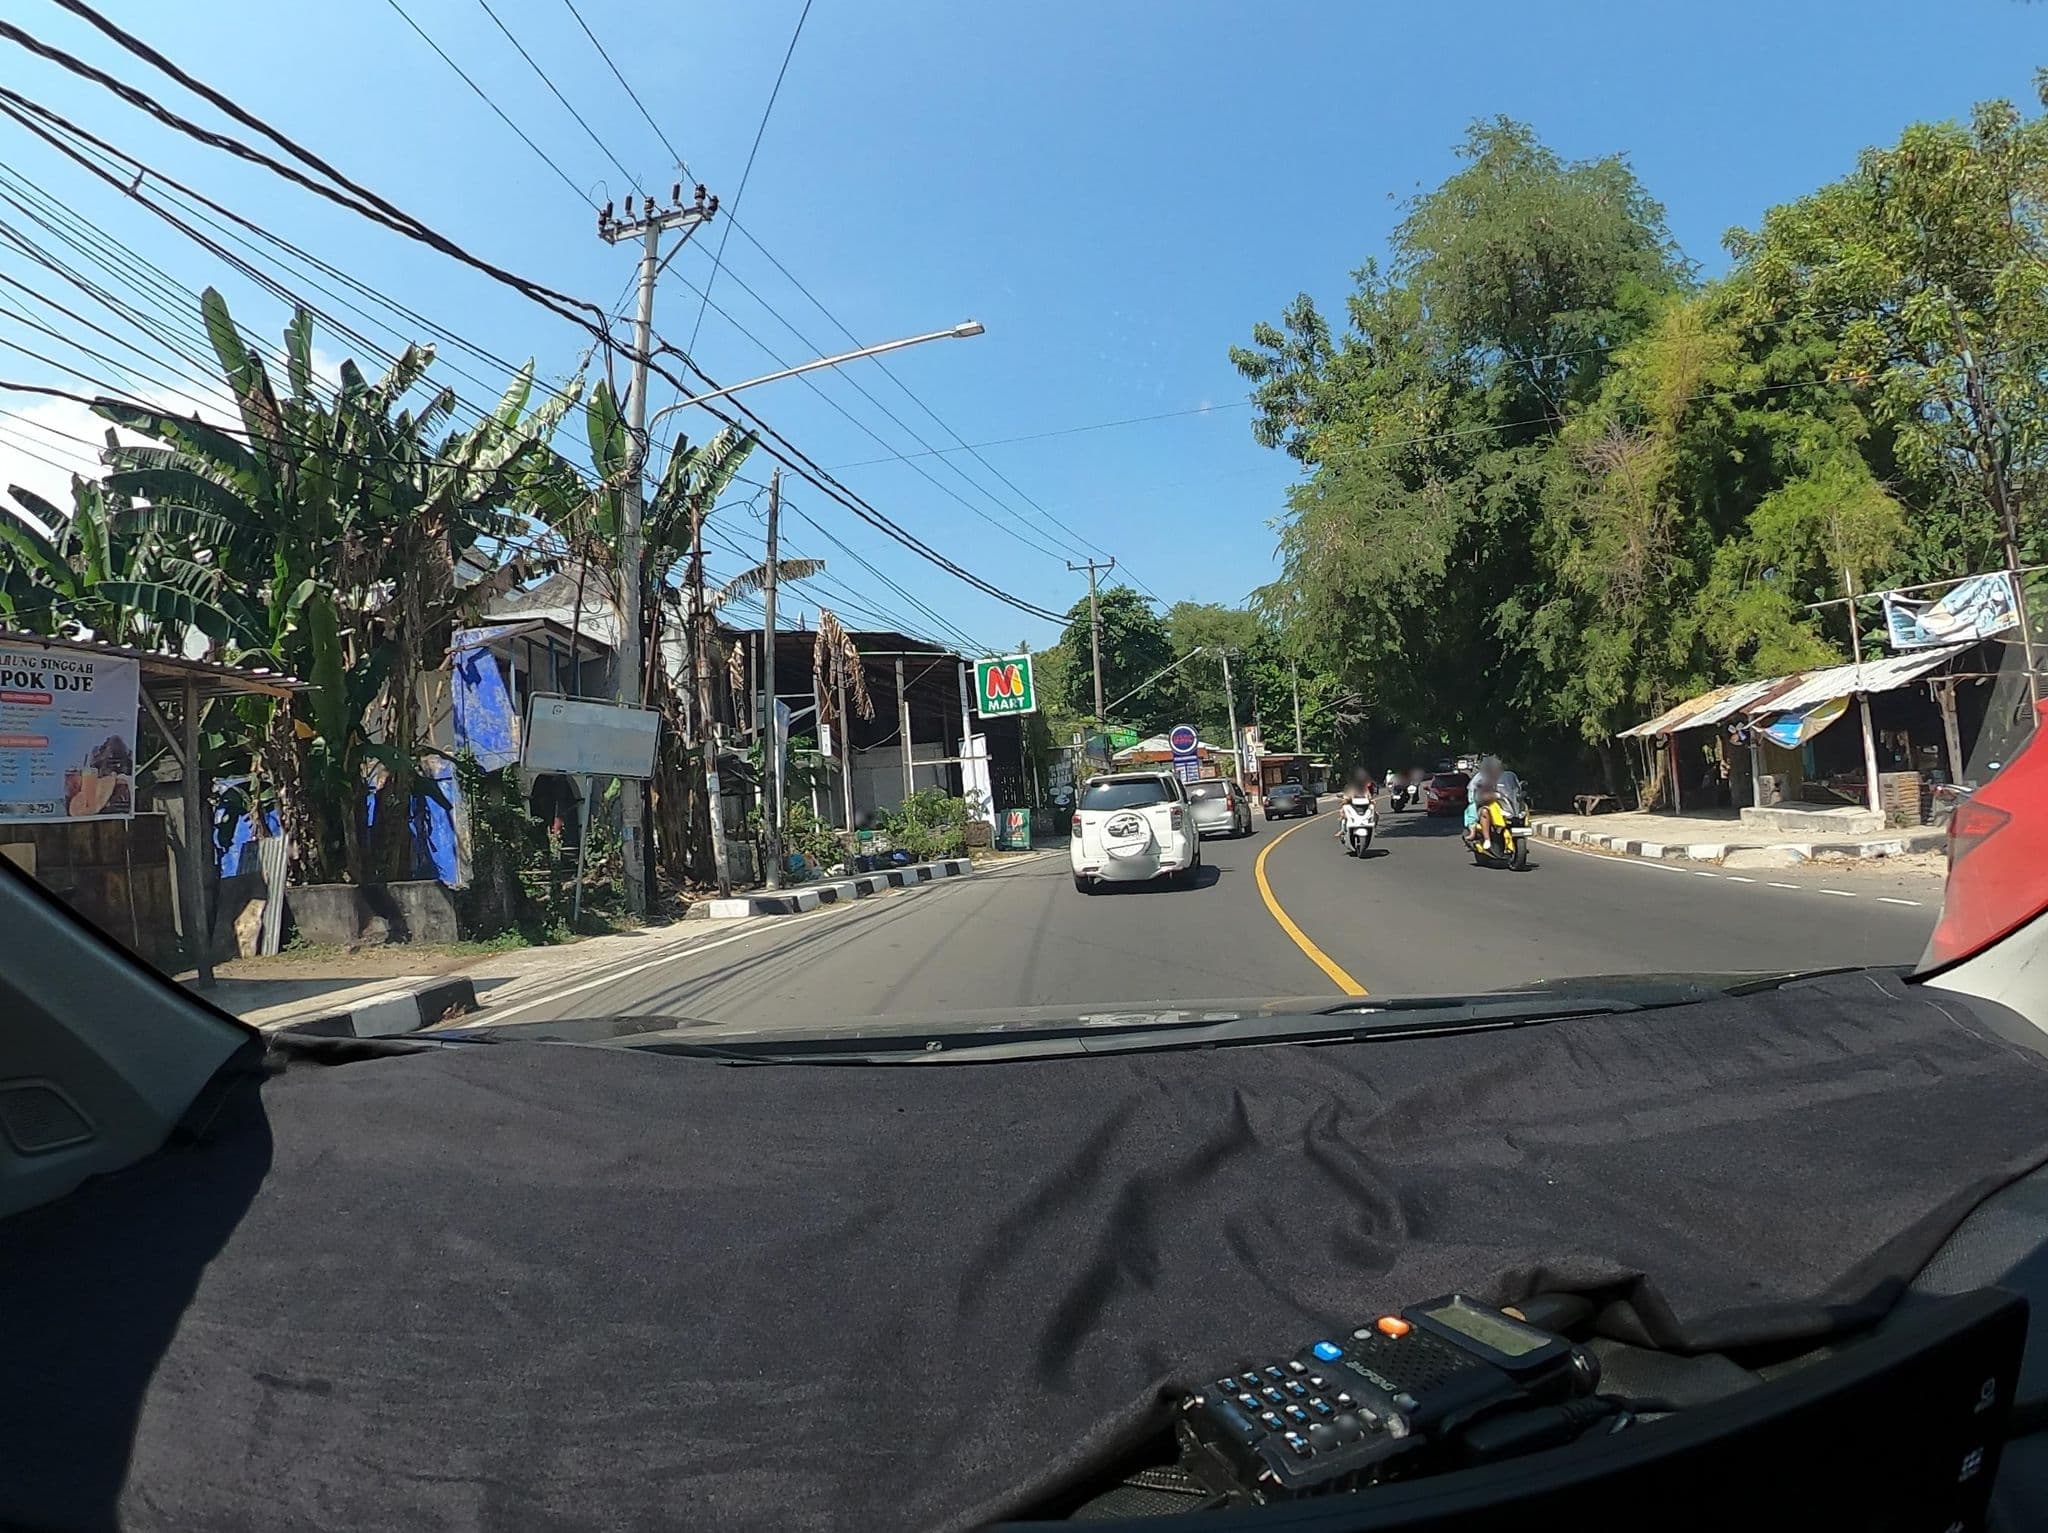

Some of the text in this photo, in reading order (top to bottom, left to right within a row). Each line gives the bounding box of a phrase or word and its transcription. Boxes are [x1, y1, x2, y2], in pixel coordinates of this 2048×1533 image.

[41, 659, 94, 674] SINGGAH
[54, 674, 94, 692] DJE
[988, 697, 1025, 711] MART
